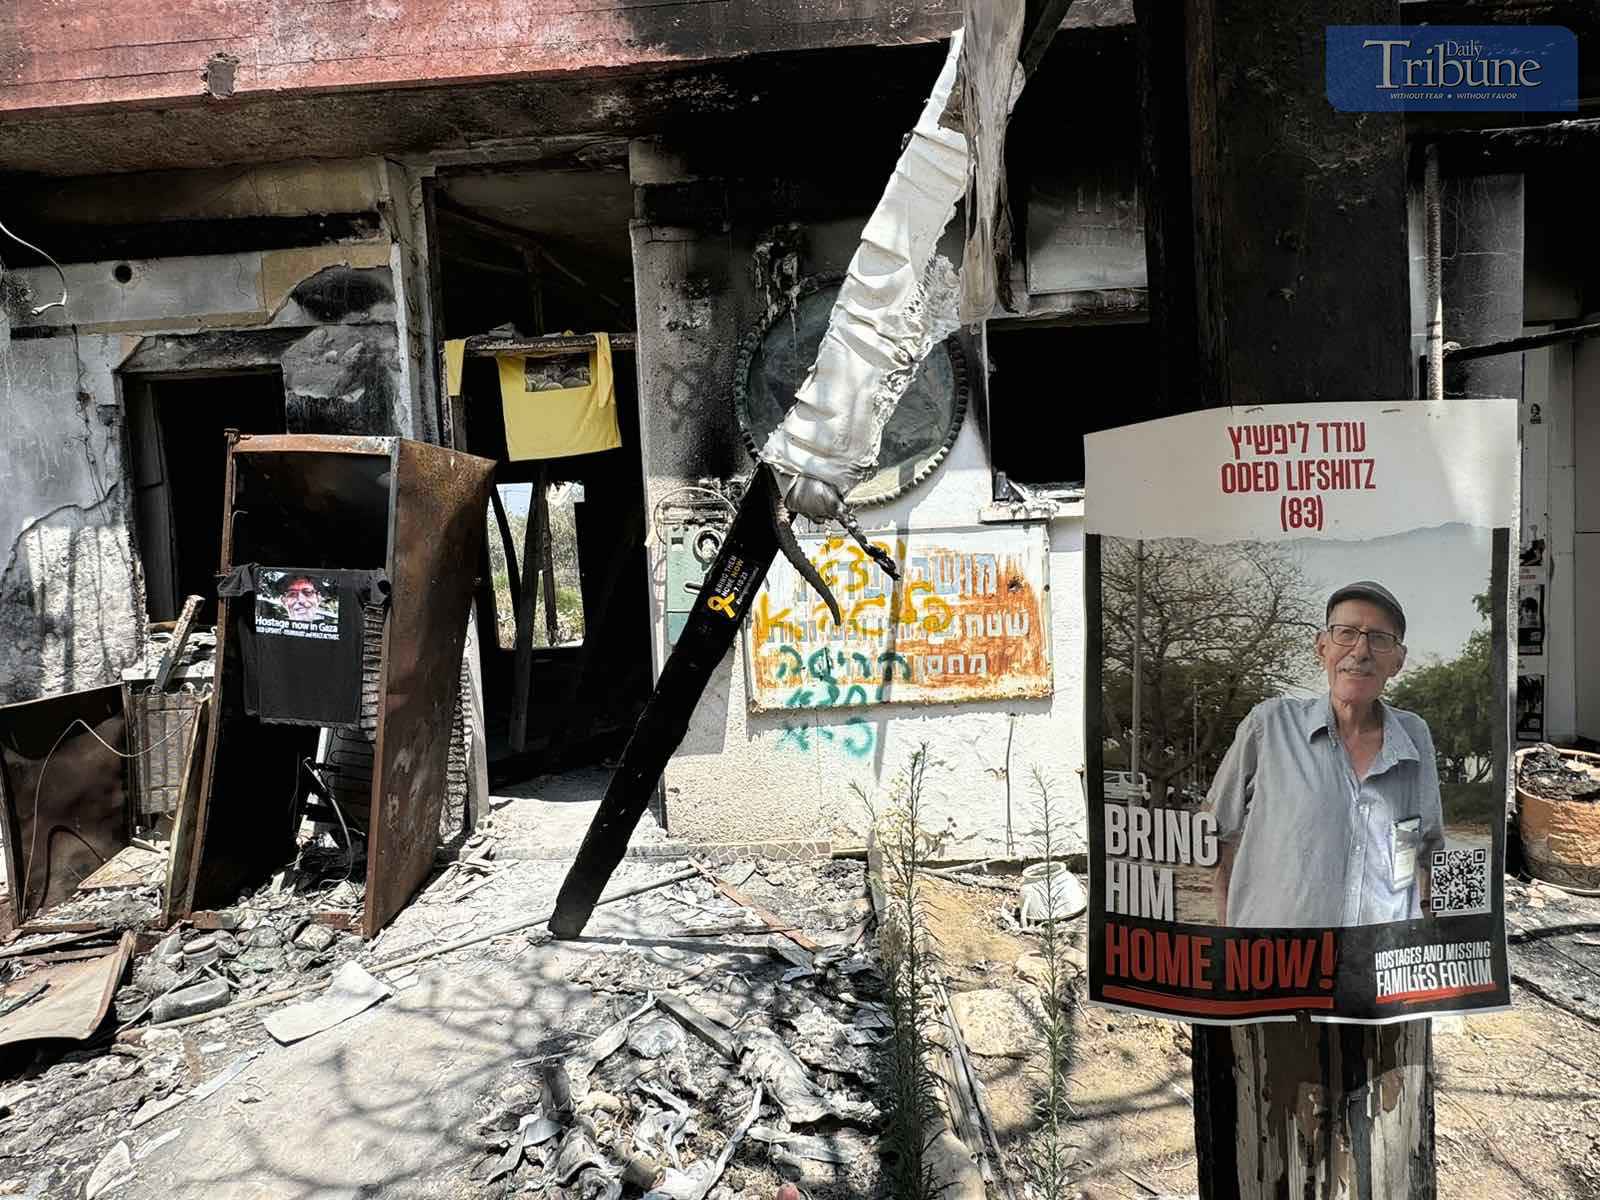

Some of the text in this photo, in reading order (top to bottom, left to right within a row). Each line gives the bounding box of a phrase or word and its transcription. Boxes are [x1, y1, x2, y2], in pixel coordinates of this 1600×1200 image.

[1227, 421, 1366, 460] עודד ליפשיץ
[1221, 459, 1377, 494] ODED LIFSHITZ
[1280, 494, 1324, 532] (83)
[715, 555, 737, 593] BRING THEM
[721, 559, 744, 597] HOME NOW
[255, 616, 338, 633] Hostage now in Gaza
[1104, 803, 1218, 866] BRING
[1105, 860, 1174, 922] HIM
[1105, 922, 1335, 991] HOME NOW!
[1375, 940, 1491, 970] HOSTAGES AND MISSING
[1376, 958, 1493, 998] FAMILIES FORUM
